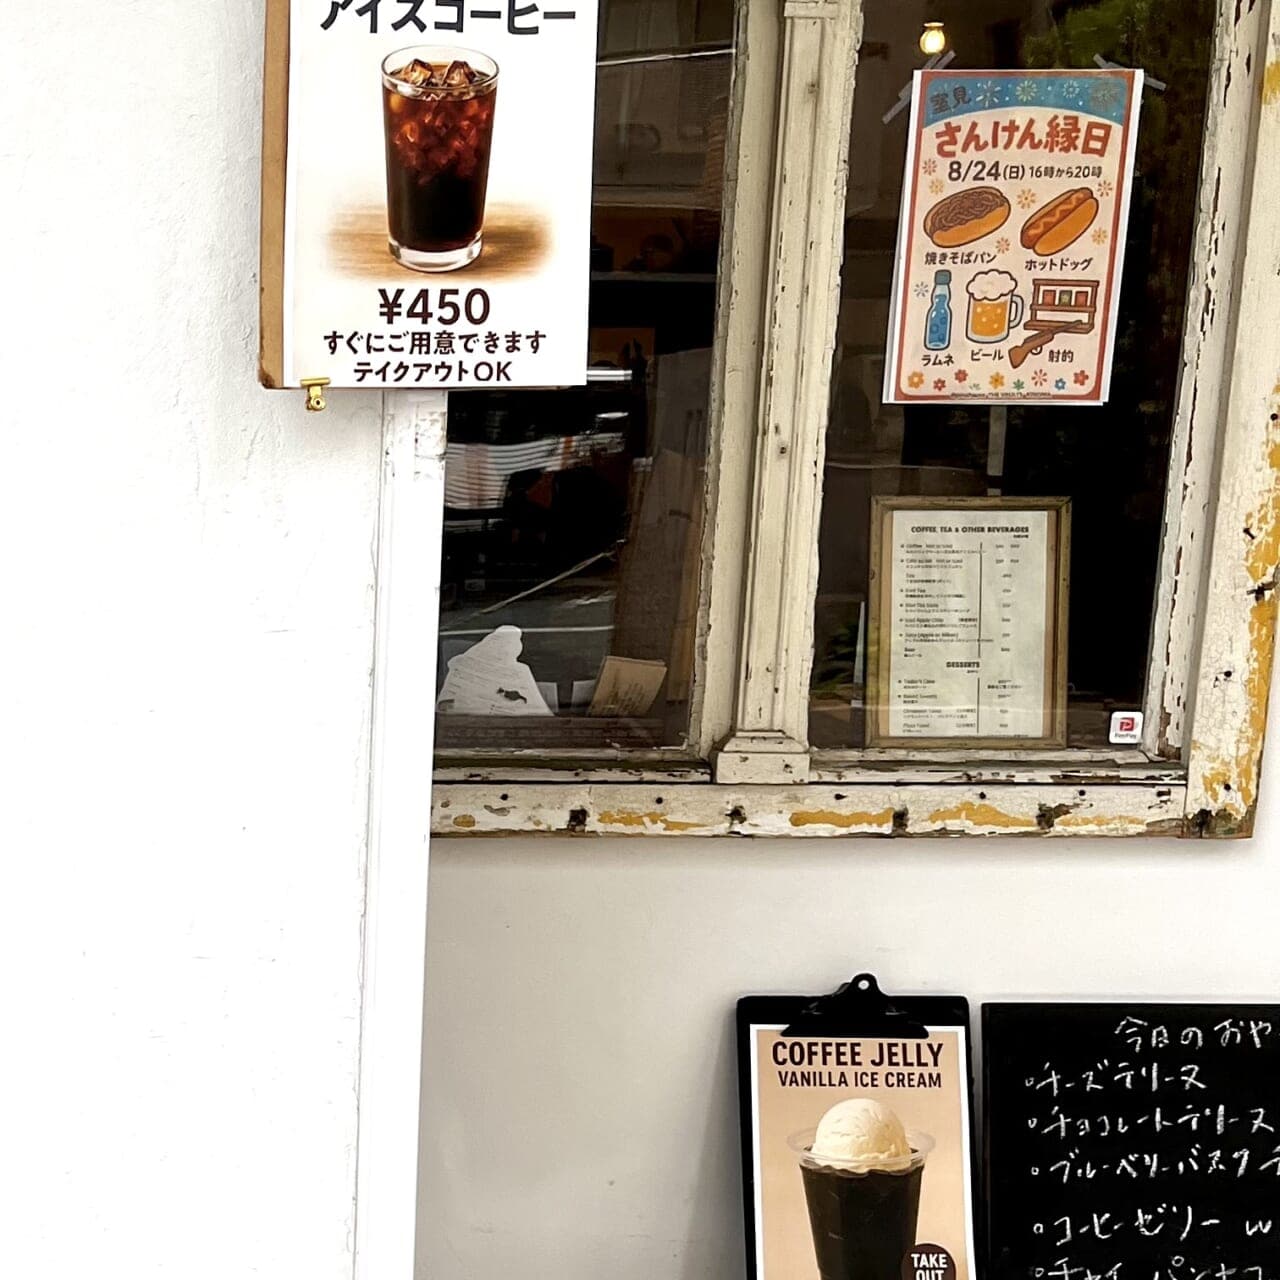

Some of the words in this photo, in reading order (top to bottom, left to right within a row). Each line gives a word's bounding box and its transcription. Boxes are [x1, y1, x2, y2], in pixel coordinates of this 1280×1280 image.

[935, 114, 1113, 159] さんけん縁日
[924, 251, 997, 266] 焼きそばパン
[1024, 257, 1094, 272] ホットドッグ
[377, 288, 491, 326] ¥450
[323, 330, 547, 356] すぐにご用意できます
[921, 353, 955, 367] ラムネ
[970, 349, 1004, 362] ビール
[1047, 349, 1074, 363] 射的
[353, 361, 513, 383] テイクアウトOK
[772, 1040, 863, 1067] COFFEE
[870, 1042, 944, 1068] JELLY
[778, 1070, 849, 1088] VANILLA
[854, 1071, 879, 1088] ICE
[885, 1071, 942, 1089] CREAM
[910, 1253, 949, 1268] TAKE
